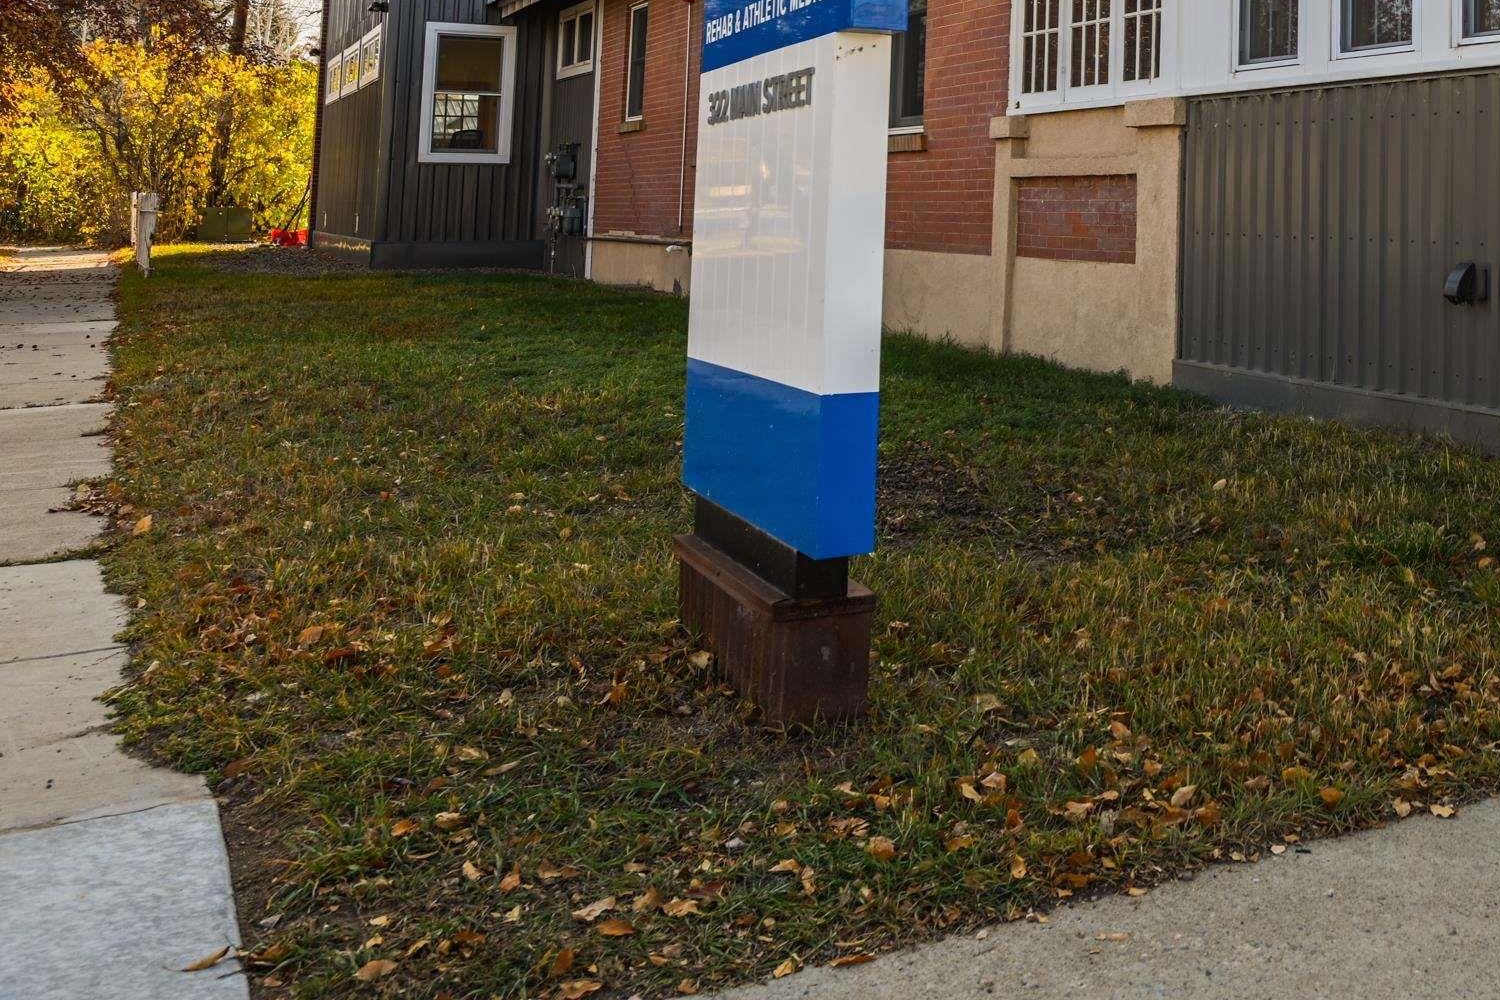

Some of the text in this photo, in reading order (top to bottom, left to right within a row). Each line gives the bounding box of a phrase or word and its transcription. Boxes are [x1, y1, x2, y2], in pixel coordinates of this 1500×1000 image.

[706, 13, 733, 44] REHAB
[735, 10, 741, 33] &
[762, 67, 815, 114] STREET
